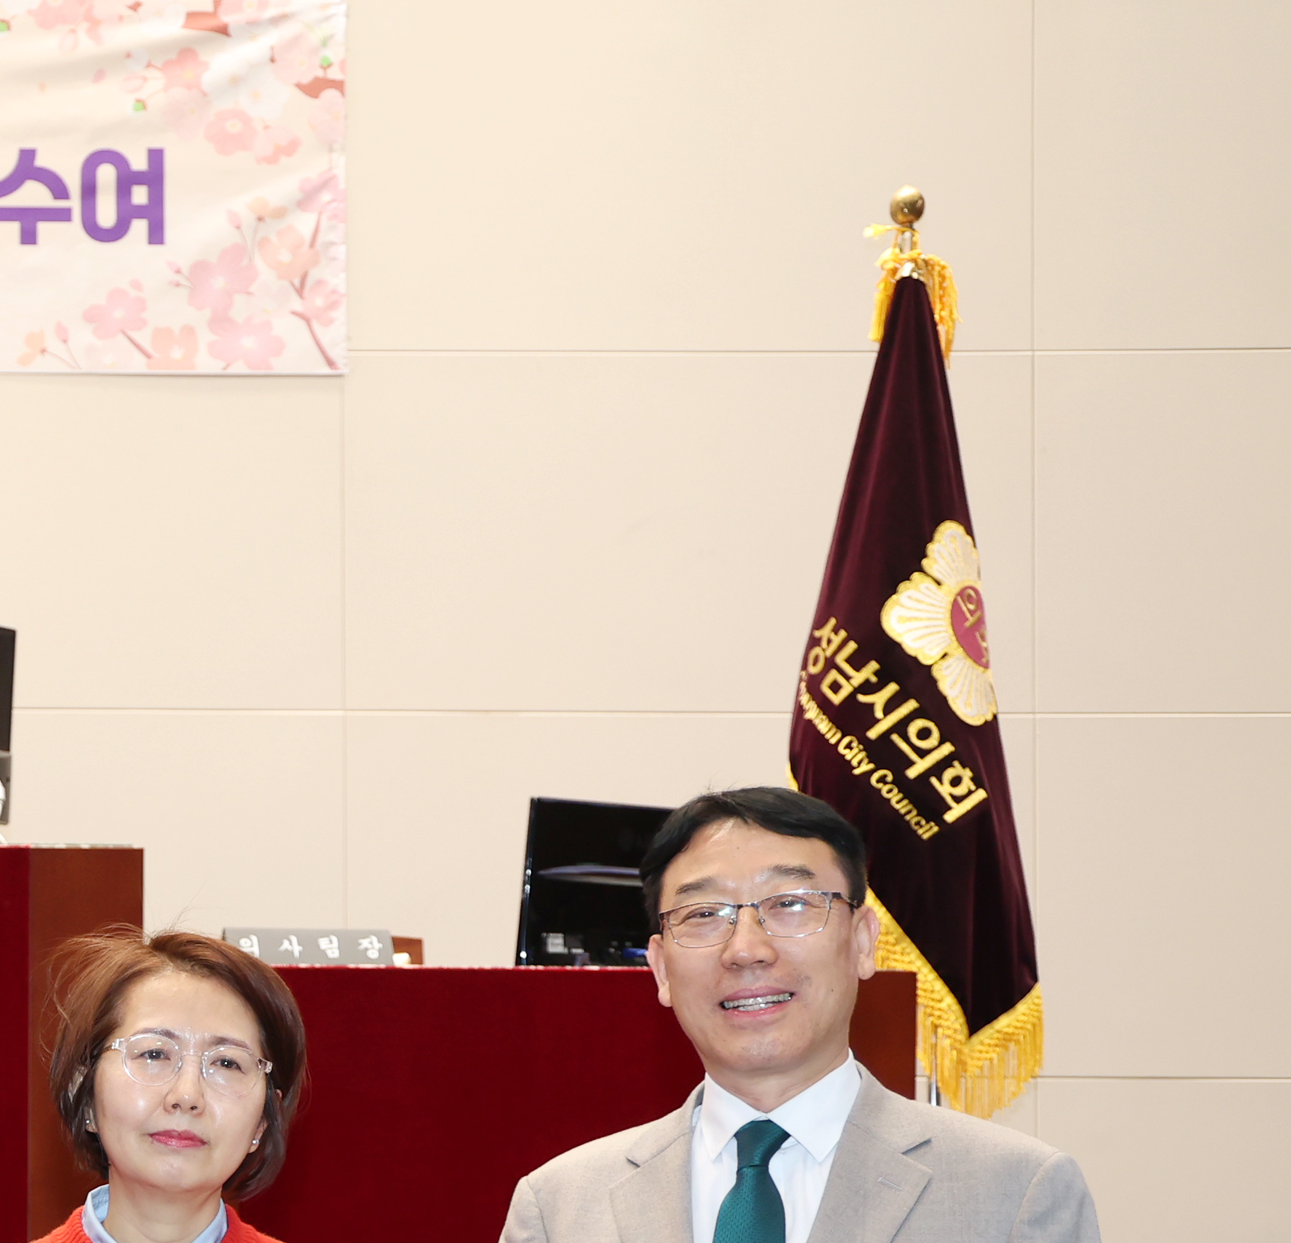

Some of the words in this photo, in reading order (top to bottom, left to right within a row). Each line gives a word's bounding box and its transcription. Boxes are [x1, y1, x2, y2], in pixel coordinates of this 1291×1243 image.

[800, 670, 843, 745] ngnam
[837, 735, 876, 775] City
[870, 769, 940, 840] Council
[807, 617, 988, 824] 성남시의회
